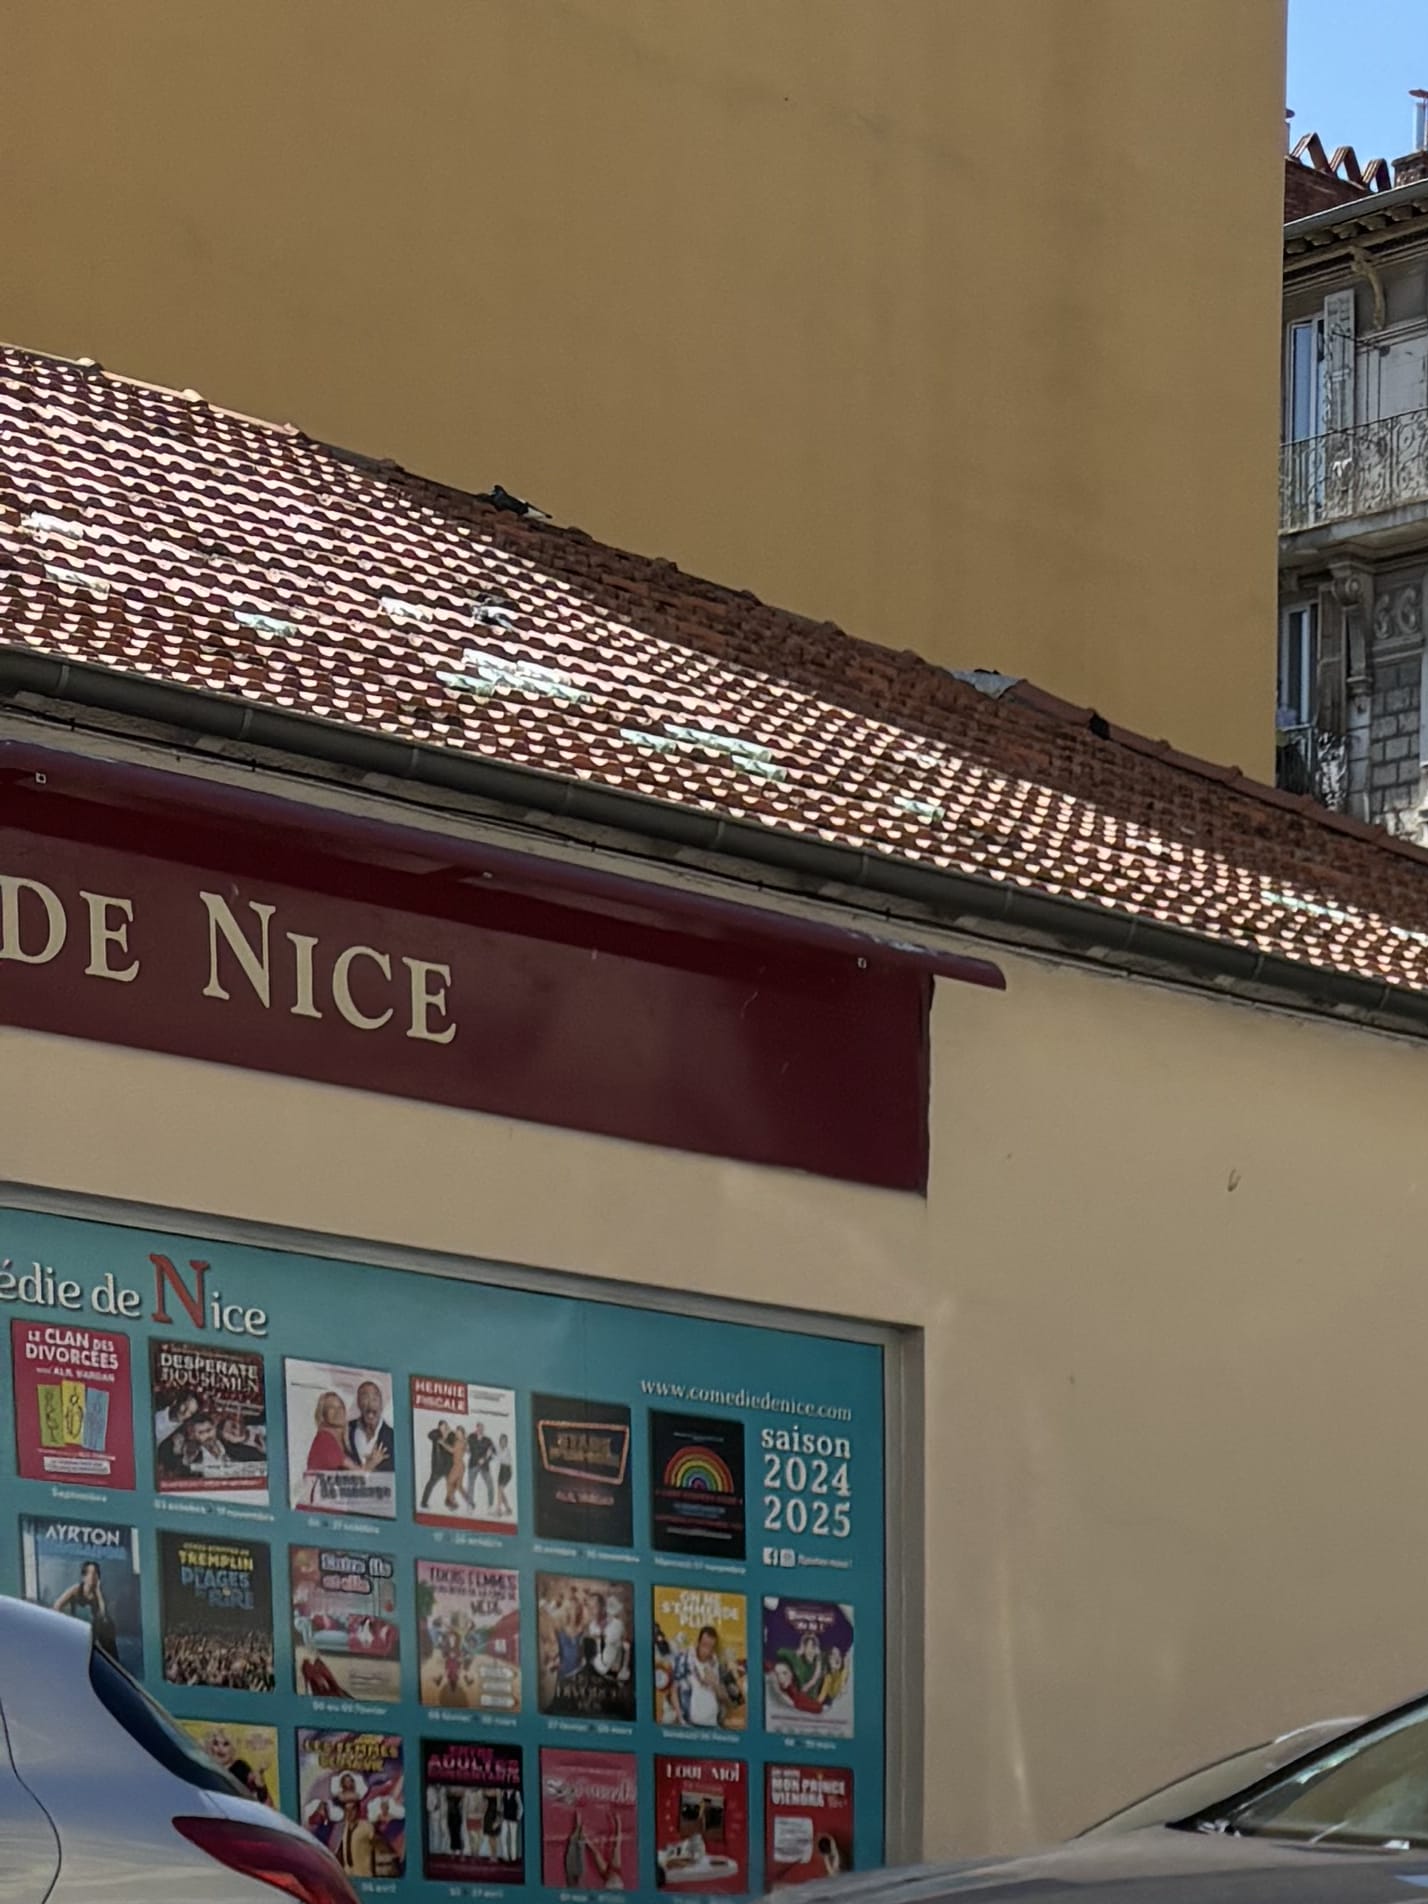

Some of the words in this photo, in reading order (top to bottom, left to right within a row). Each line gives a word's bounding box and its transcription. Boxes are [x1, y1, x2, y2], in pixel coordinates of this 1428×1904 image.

[0, 875, 142, 985] DE
[200, 890, 458, 1045] NICE
[91, 1273, 142, 1317] de
[149, 1252, 268, 1336] Nice
[45, 1328, 90, 1350] CLAN
[93, 1338, 115, 1352] DES
[640, 1378, 852, 1422] www.comediedenice.com
[761, 1425, 852, 1460] saison
[763, 1453, 852, 1497] 2024
[45, 1523, 120, 1546] AYRTON
[763, 1494, 851, 1539] 2025
[178, 1549, 254, 1572] TREMPLIN
[181, 1566, 250, 1587] PLAGES
